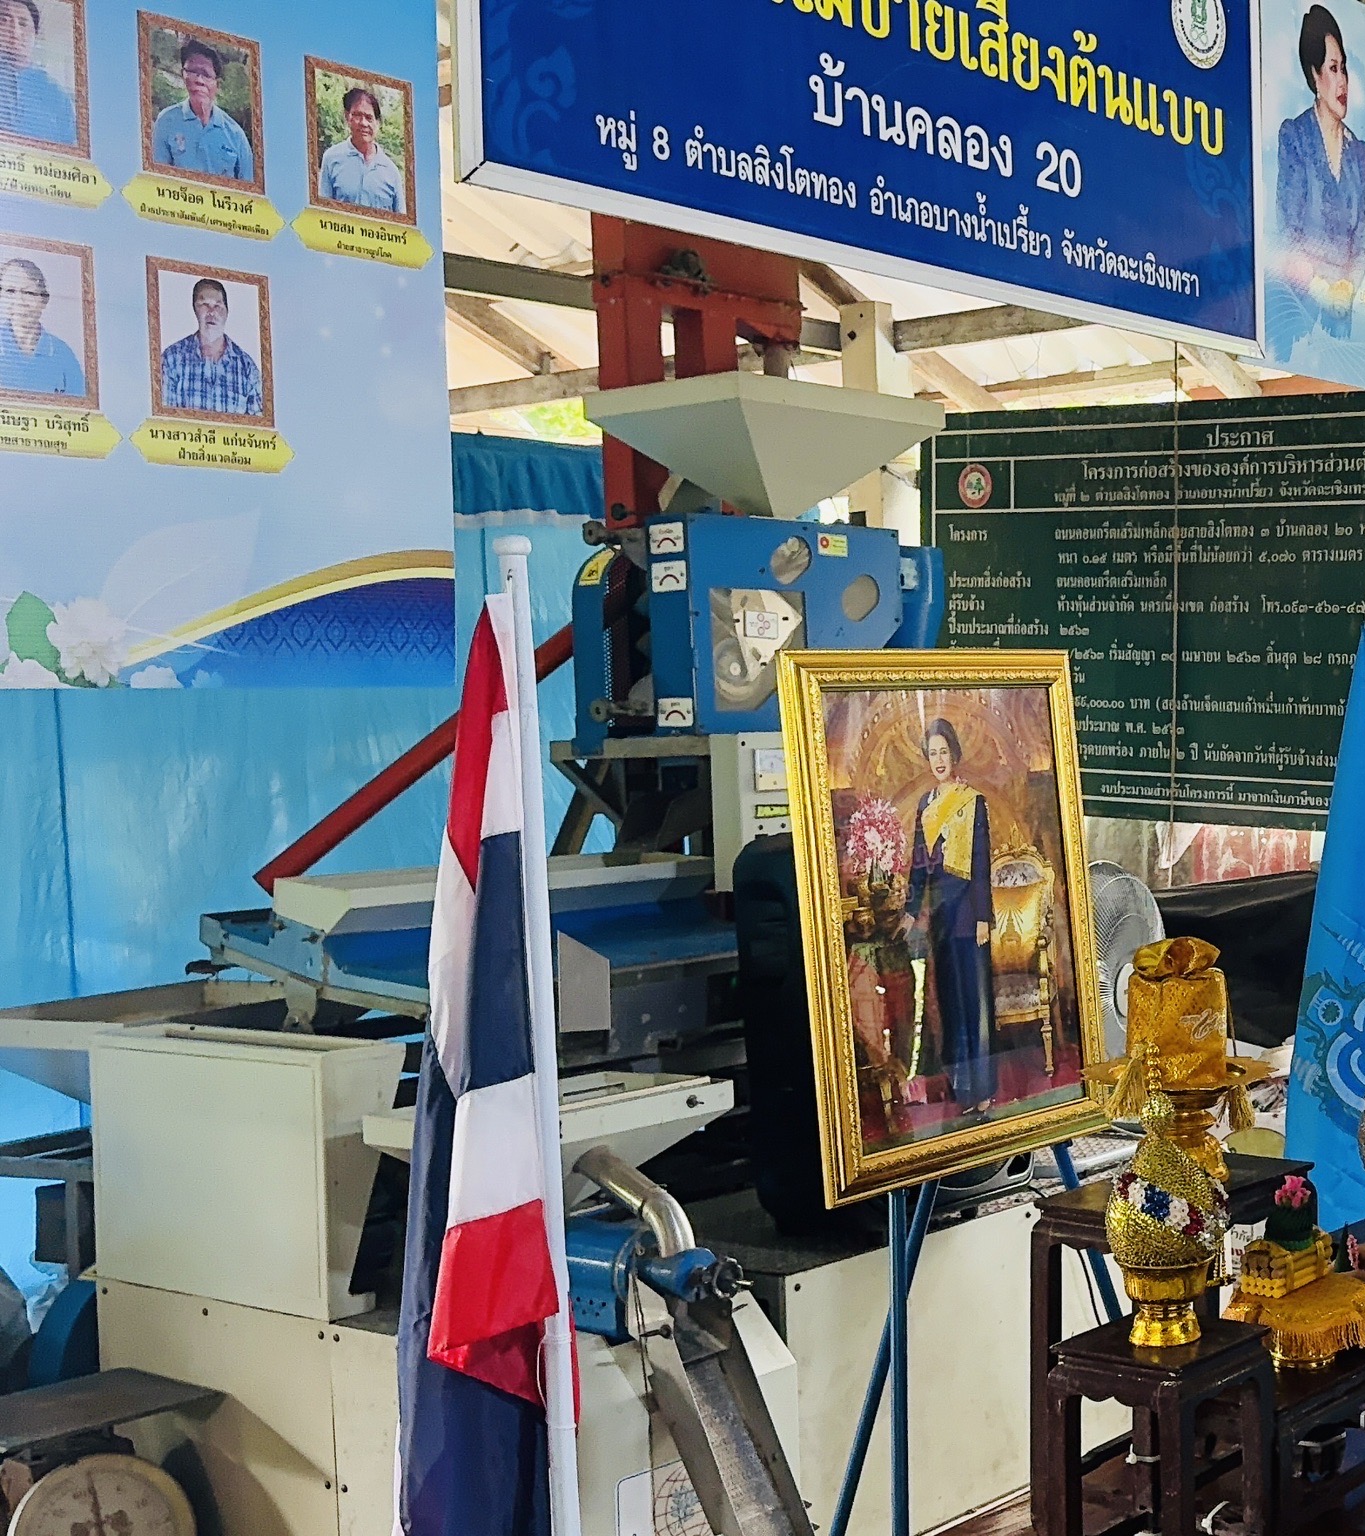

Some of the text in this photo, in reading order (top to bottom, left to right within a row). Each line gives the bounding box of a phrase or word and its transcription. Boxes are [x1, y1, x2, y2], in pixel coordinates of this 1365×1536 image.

[809, 53, 1083, 198] บ้านคลอง 20
[596, 111, 1200, 298] หมู่ 8 ตำบลสิงโตทอง อำเภอบางน้ำเปรี้ยว จังหวัดฉะเชิงเทรา
[319, 219, 407, 245] นายสม ทองอินทร์
[45, 412, 91, 437] บริสุทธิ์
[150, 428, 277, 450] นางสาวสำลี แก่นจันทร์
[1207, 425, 1275, 449] ประกาศ
[949, 524, 988, 541] โครงการ
[1276, 519, 1329, 538] บ้านคลอง
[1335, 525, 1353, 536] ๒๐
[1058, 552, 1078, 565] หนา
[1112, 551, 1138, 564] เมตร
[1302, 548, 1363, 563] ตารางเมตร
[1210, 595, 1249, 613] ก่อสร้าง
[1182, 649, 1222, 663] เมษายน
[1266, 640, 1298, 669] สิ้นสุด
[1131, 697, 1150, 710] บาท
[1152, 722, 1185, 735] ๒๕๓
